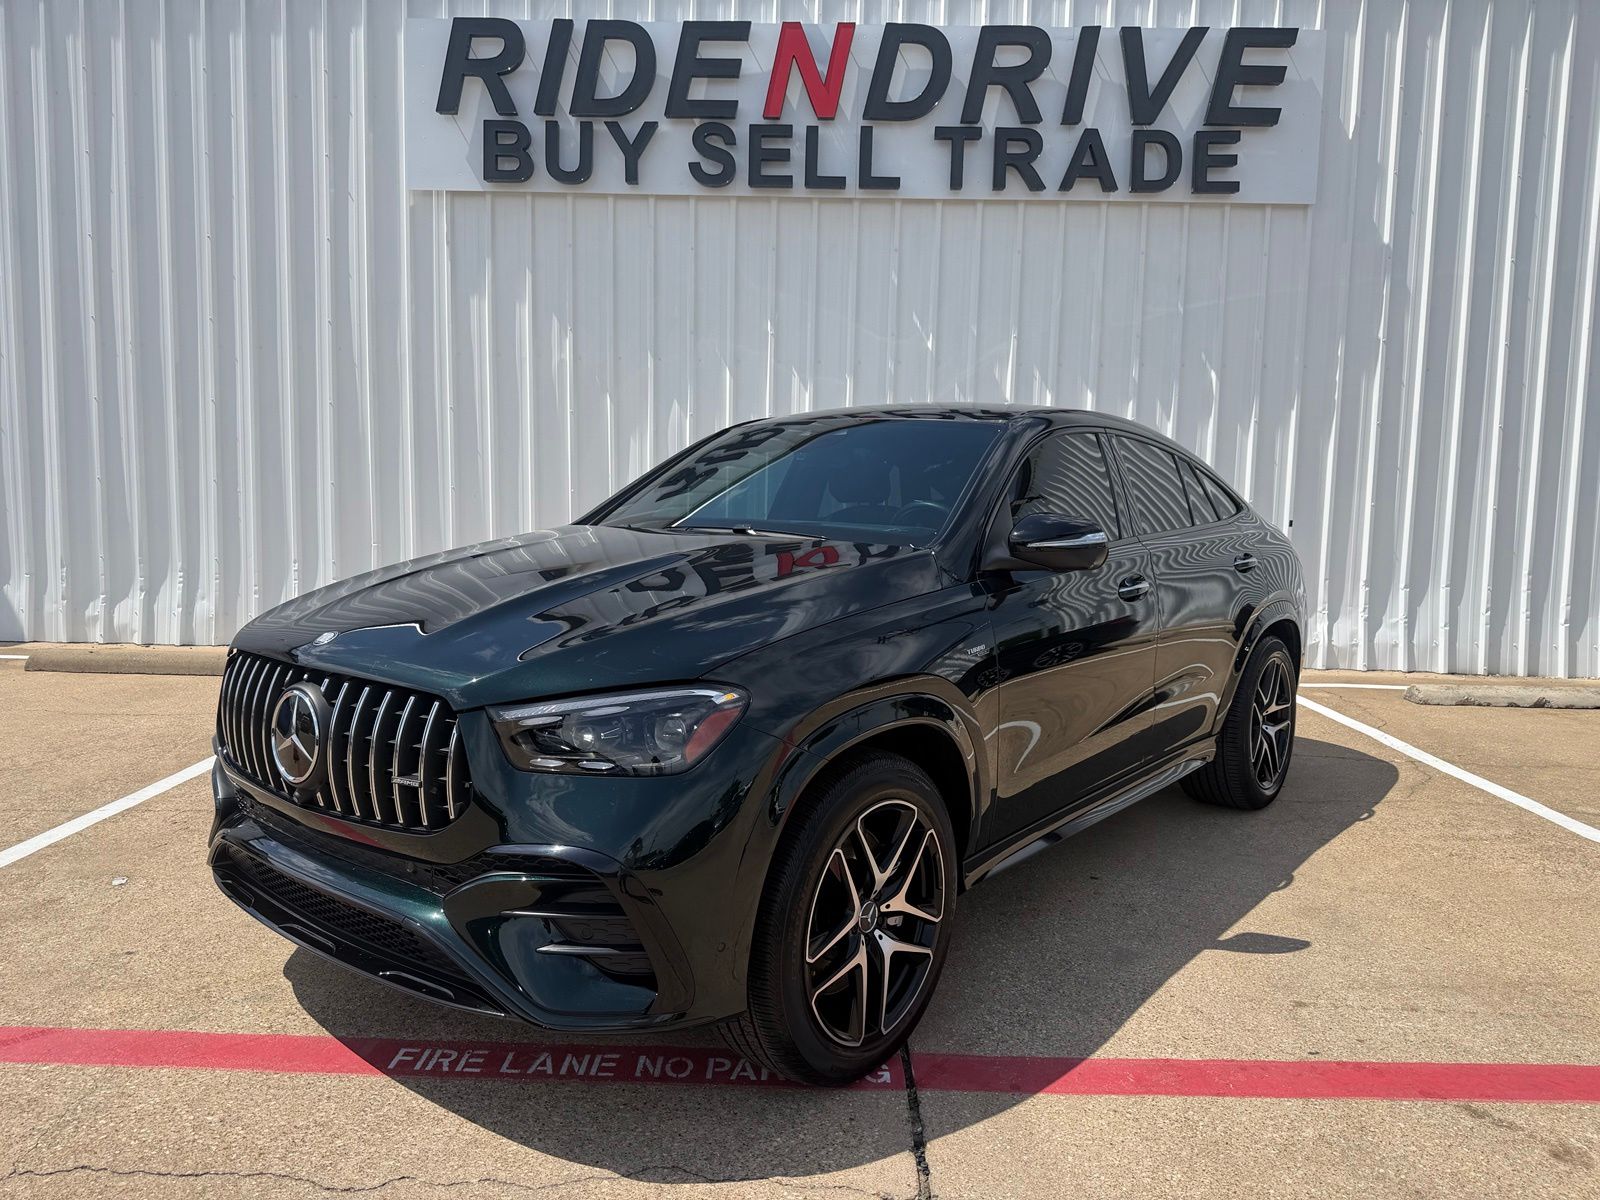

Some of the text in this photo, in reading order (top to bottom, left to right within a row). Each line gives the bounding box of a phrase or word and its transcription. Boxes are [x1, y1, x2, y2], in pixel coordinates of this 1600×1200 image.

[483, 119, 1241, 194] BUY SELL TRADE
[387, 1047, 489, 1073] FIRE
[499, 1052, 621, 1076] LANE
[634, 1055, 695, 1078] NO
